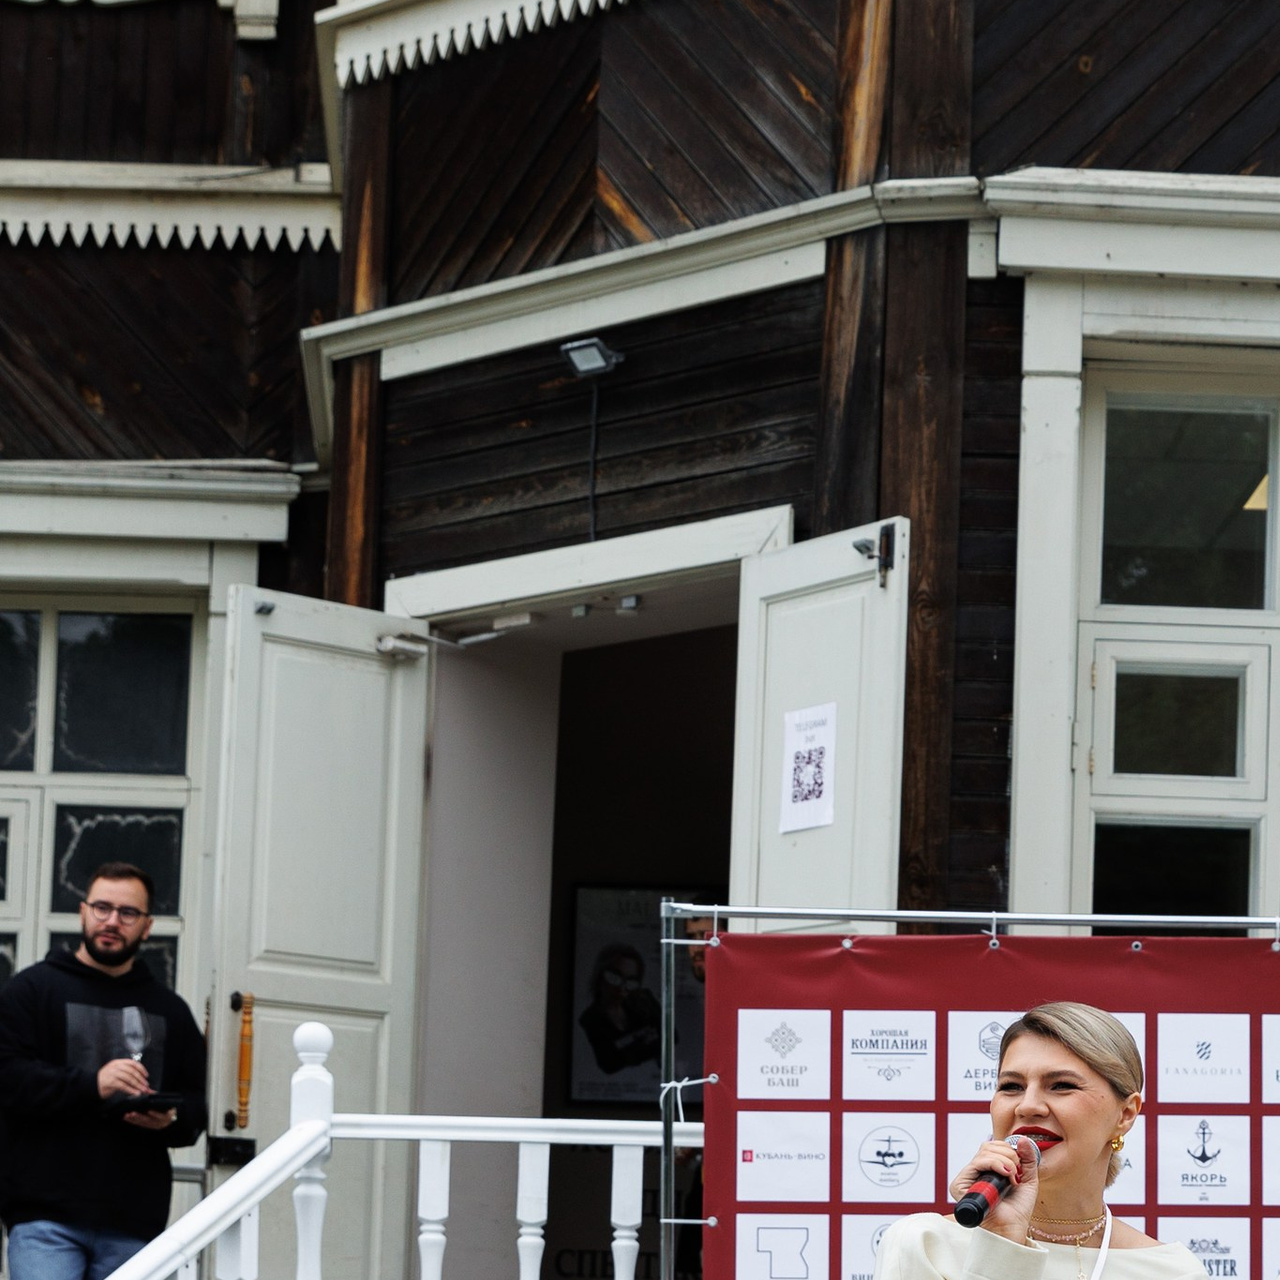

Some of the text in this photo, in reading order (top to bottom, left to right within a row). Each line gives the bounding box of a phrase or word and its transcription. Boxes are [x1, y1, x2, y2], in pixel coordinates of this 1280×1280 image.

[870, 1029, 909, 1037] ХОРОШАЯ
[851, 1039, 928, 1050] КОМПАНИЯ
[760, 1065, 808, 1075] СОБЕР
[767, 1078, 799, 1087] БАШ
[1181, 1174, 1227, 1183] ЯКОРЬ
